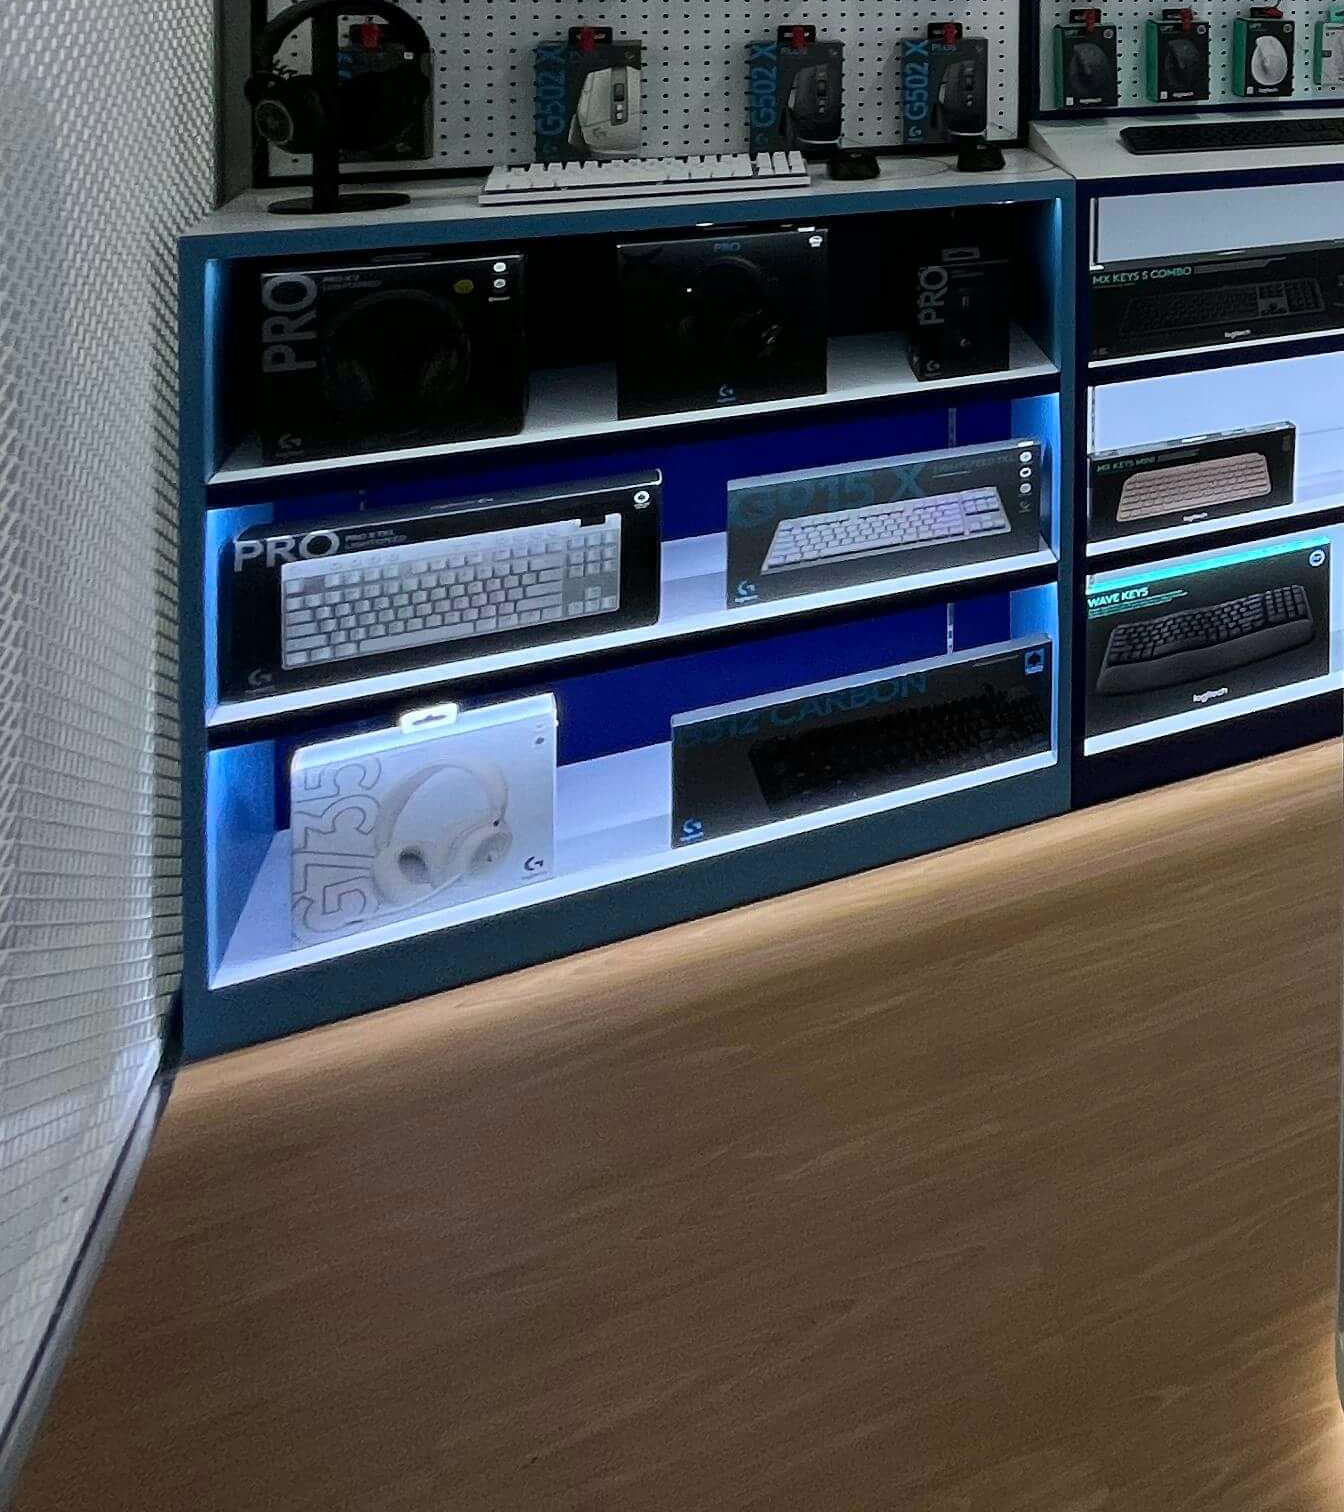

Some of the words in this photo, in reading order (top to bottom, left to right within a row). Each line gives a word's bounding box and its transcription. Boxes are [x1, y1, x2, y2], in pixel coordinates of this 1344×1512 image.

[917, 264, 949, 327] PRO
[1092, 273, 1111, 286] MX
[1112, 270, 1140, 284] KEYS
[1150, 265, 1193, 280] COMBO
[261, 273, 319, 375] PRO
[233, 528, 341, 574] PRO
[1087, 593, 1120, 609] WAVE
[1120, 586, 1150, 603] KEYS
